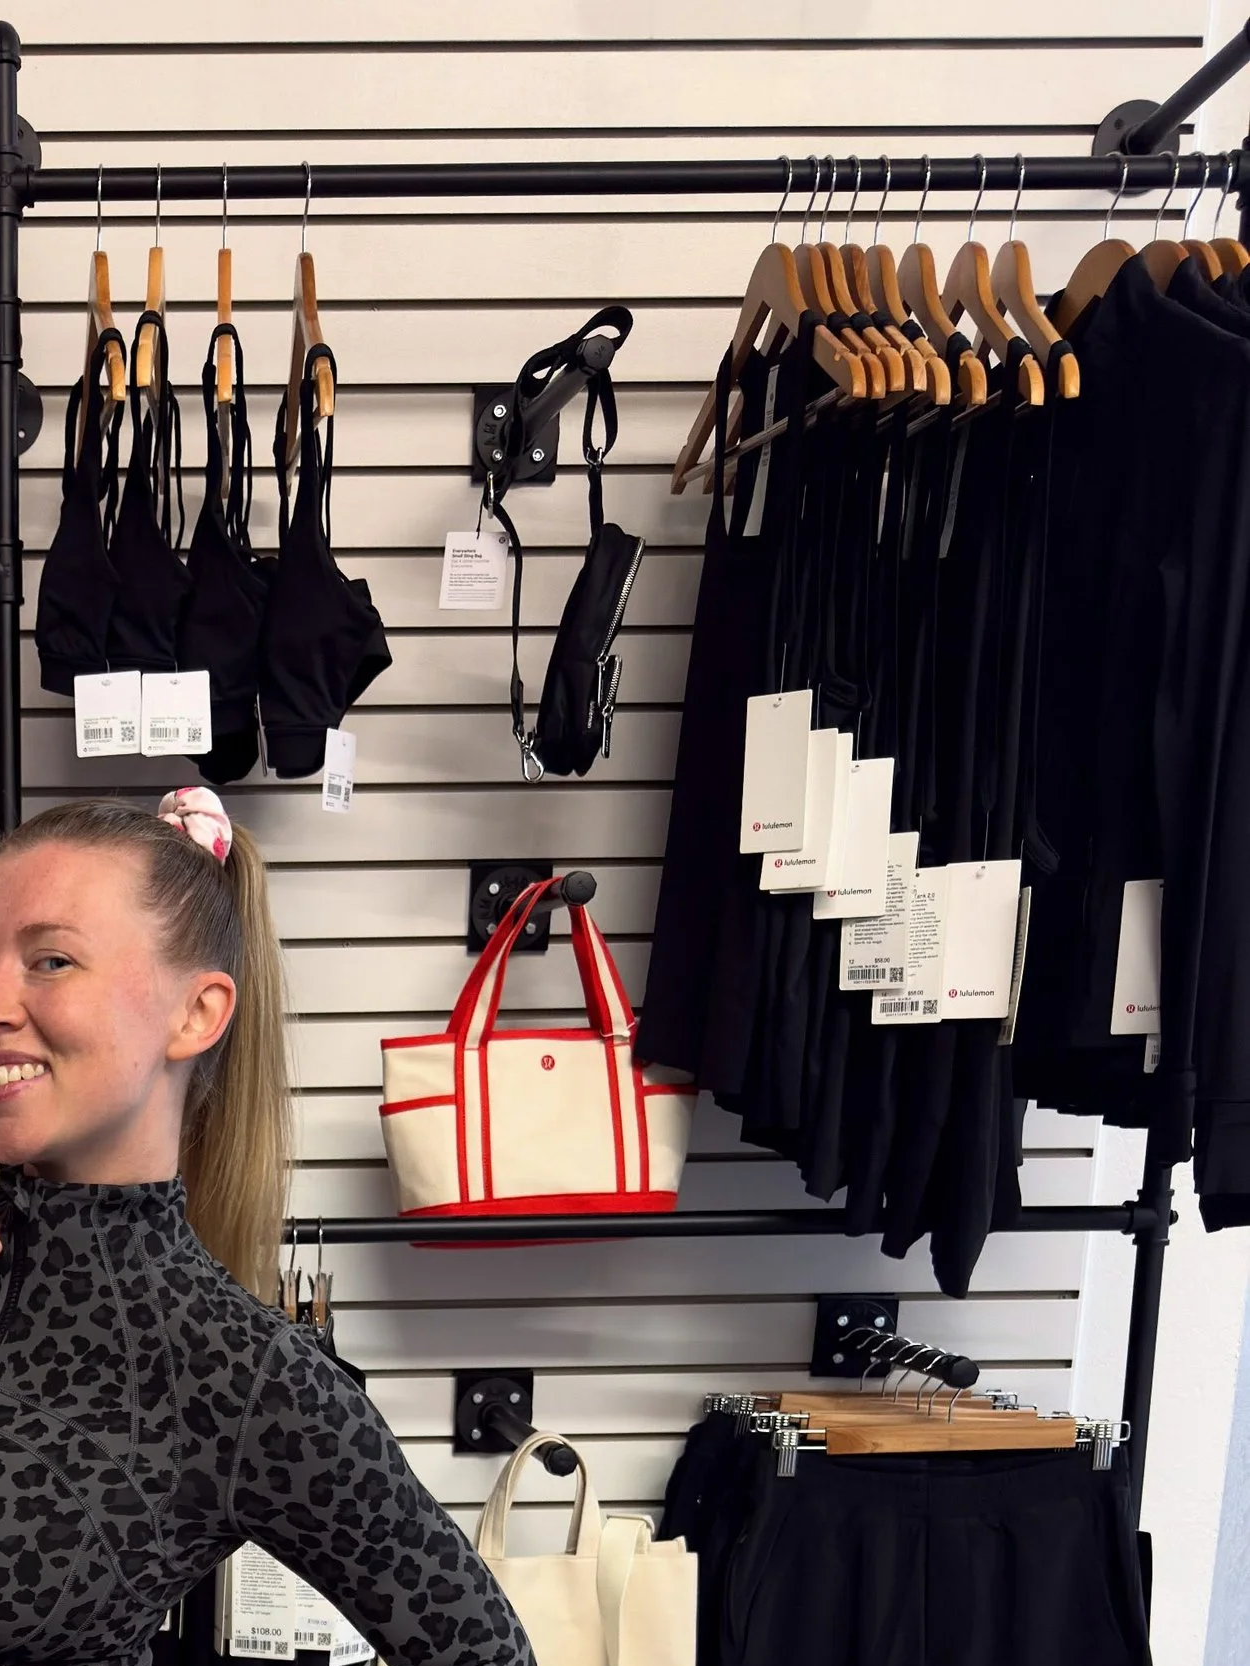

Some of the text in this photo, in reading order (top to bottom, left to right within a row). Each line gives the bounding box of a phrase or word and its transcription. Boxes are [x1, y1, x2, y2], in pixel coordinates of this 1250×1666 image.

[762, 821, 793, 830] lululemon
[784, 858, 816, 866] lululemon
[837, 888, 872, 896] lululemon
[959, 989, 995, 997] lululemon
[1137, 1004, 1160, 1012] lulule
[251, 1627, 282, 1636] $108.00
